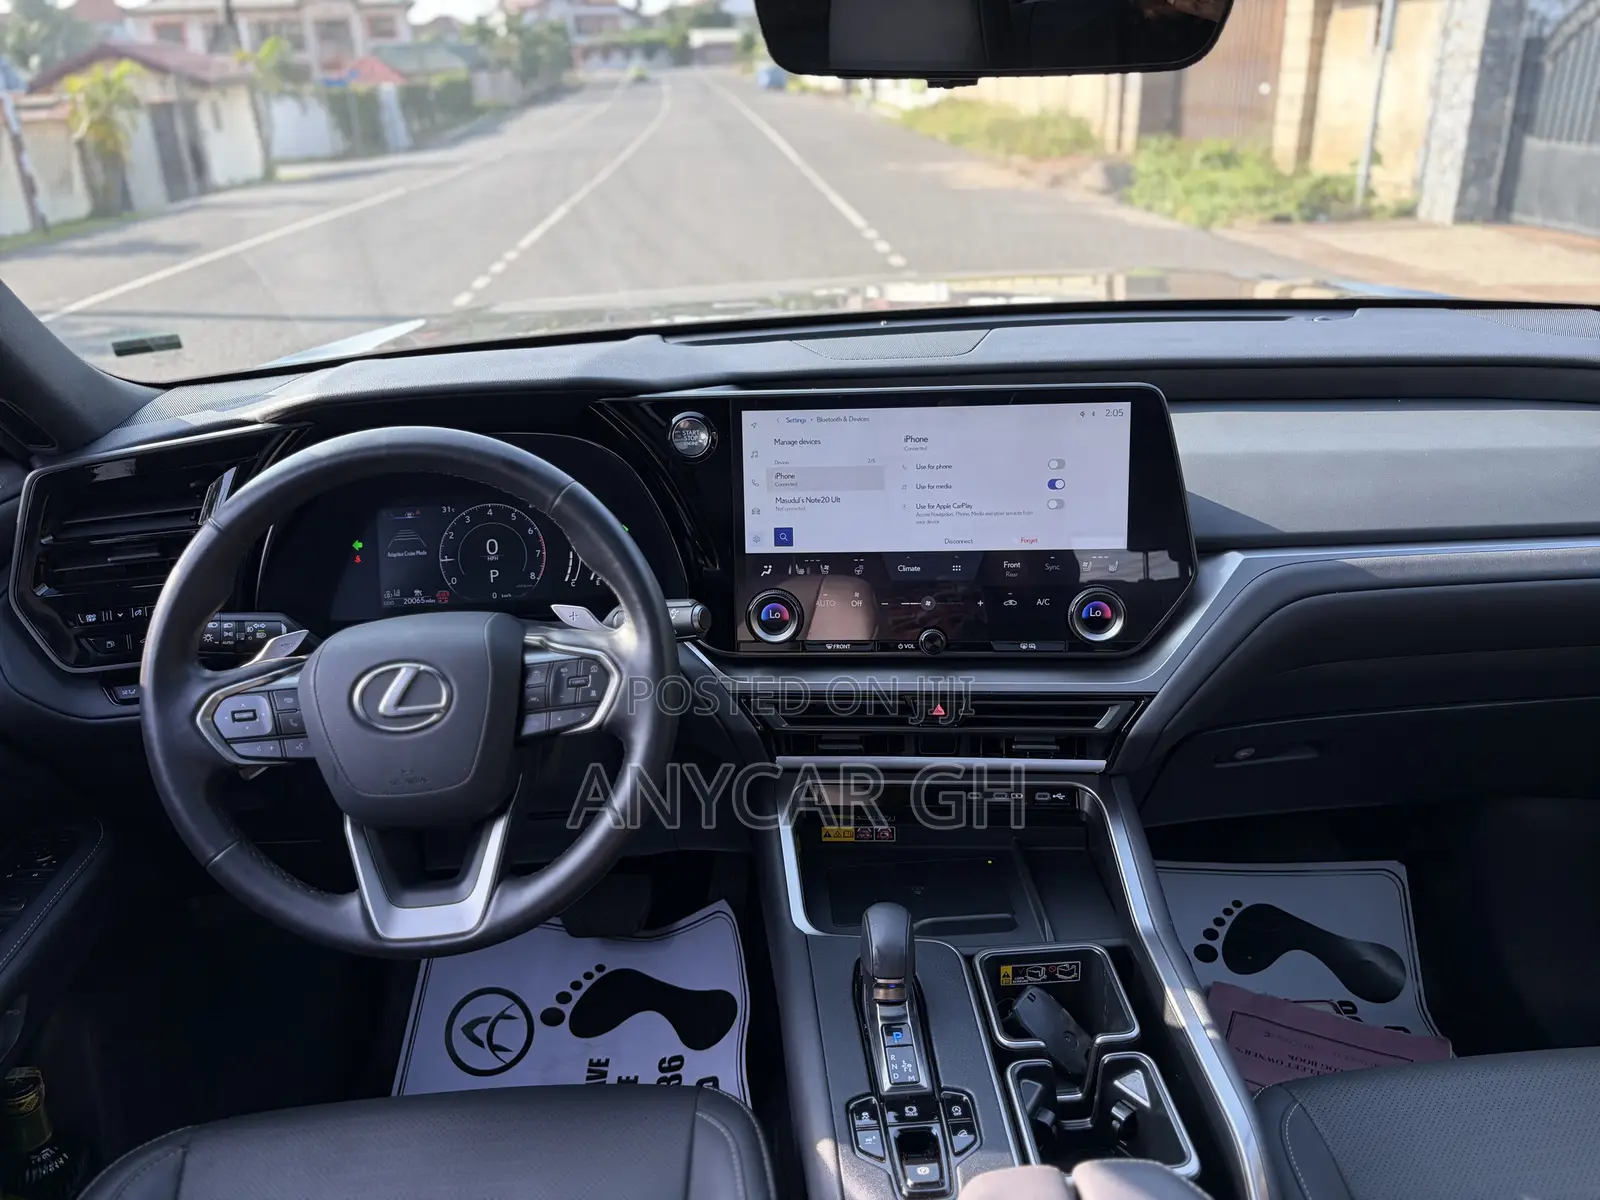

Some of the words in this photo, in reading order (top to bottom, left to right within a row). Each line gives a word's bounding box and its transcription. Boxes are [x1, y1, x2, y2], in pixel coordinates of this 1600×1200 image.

[1105, 408, 1124, 417] 2:05
[774, 438, 798, 447] Manage
[904, 434, 929, 443] iPhone
[774, 472, 796, 480] iPhone
[465, 516, 471, 524] 3
[448, 532, 454, 540] 2
[486, 538, 498, 555] 0
[536, 550, 540, 558] 7
[1044, 563, 1060, 572] Sync
[490, 570, 500, 583] P
[530, 572, 536, 580] 8
[451, 577, 458, 585] 0
[404, 597, 426, 605] 20065
[770, 610, 781, 620] Lo
[1090, 608, 1102, 618] Lo
[892, 1032, 903, 1043] P
